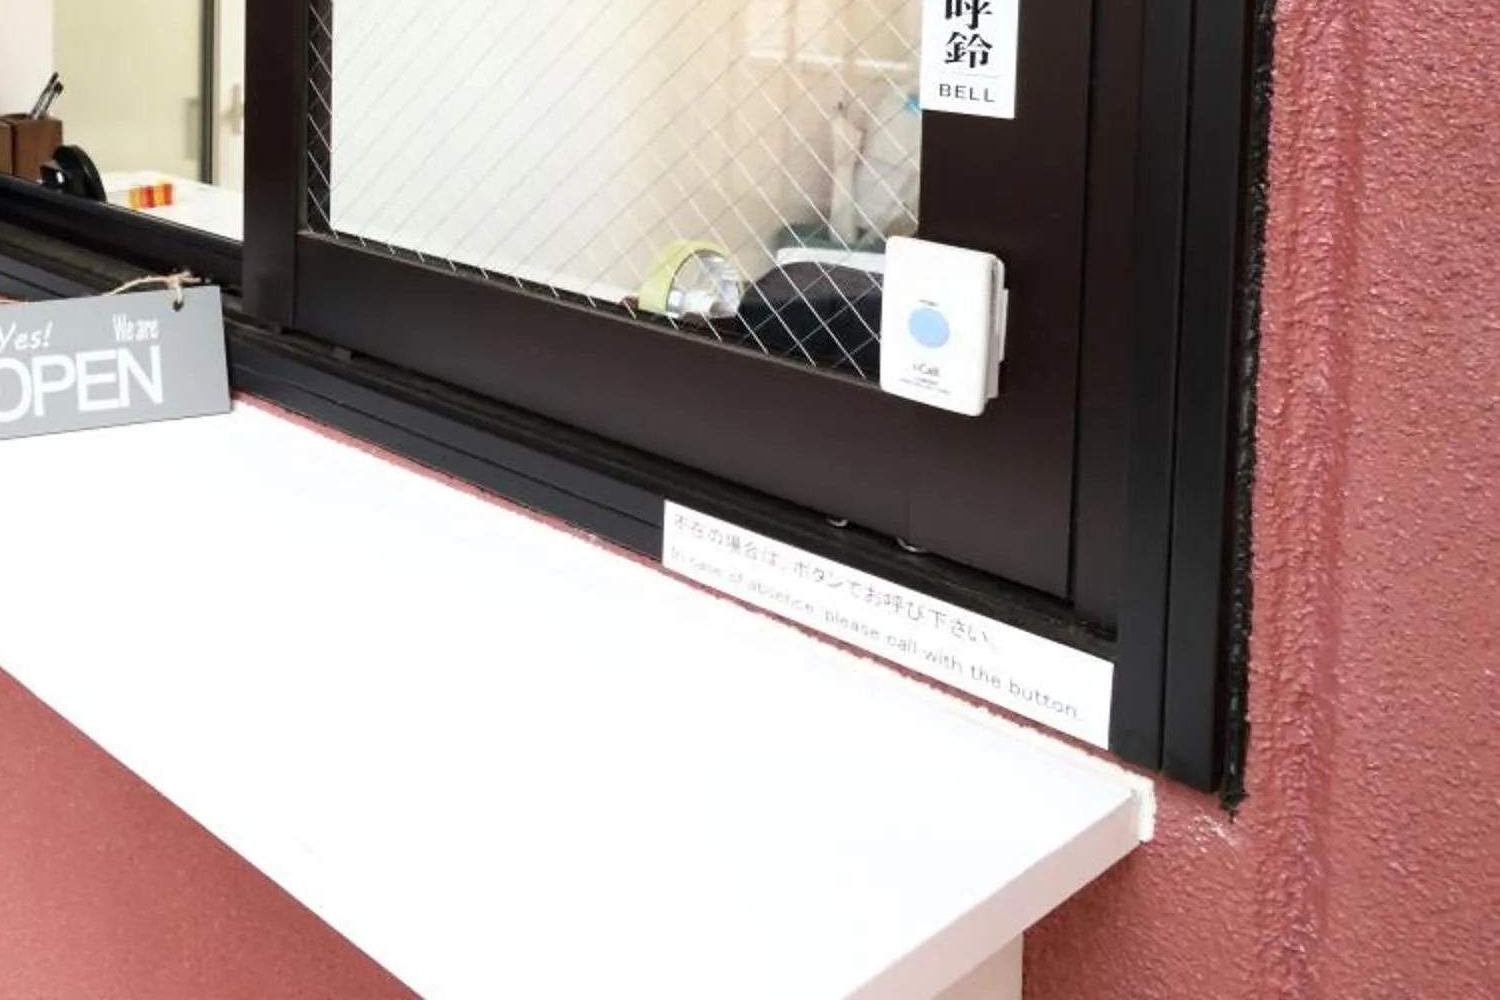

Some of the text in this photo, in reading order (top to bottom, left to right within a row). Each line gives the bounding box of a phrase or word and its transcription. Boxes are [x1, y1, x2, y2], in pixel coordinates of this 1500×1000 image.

[938, 83, 997, 103] BELL
[112, 313, 160, 341] We are
[824, 609, 880, 641] please
[886, 633, 917, 655] call
[922, 647, 963, 674] with
[970, 664, 1002, 690] the
